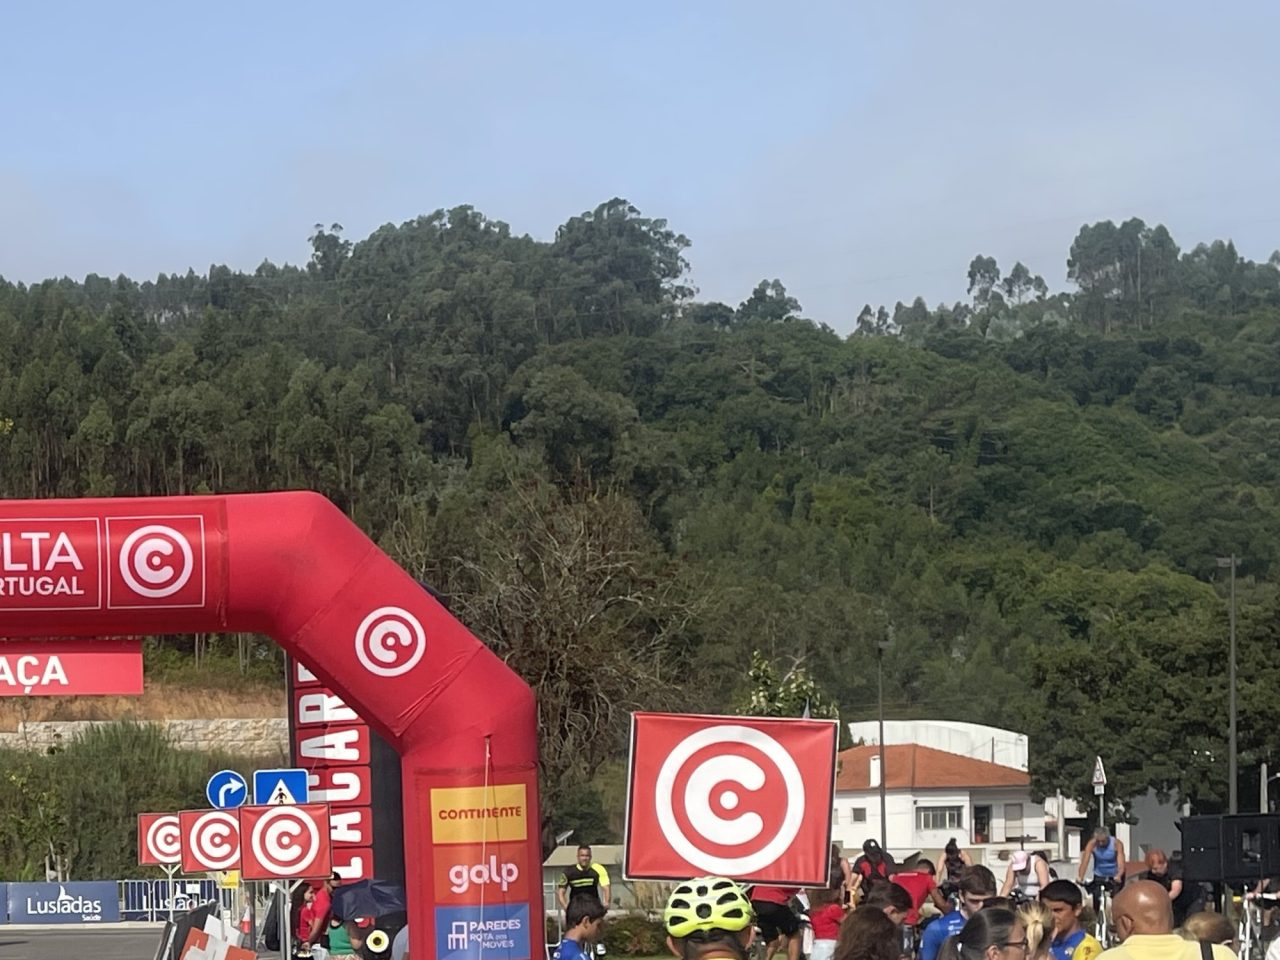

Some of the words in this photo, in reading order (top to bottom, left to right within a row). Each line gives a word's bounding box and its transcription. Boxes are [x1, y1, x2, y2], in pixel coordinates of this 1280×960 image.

[449, 855, 519, 895] galp
[470, 919, 521, 932] PAREDES
[470, 932, 494, 943] ROTA
